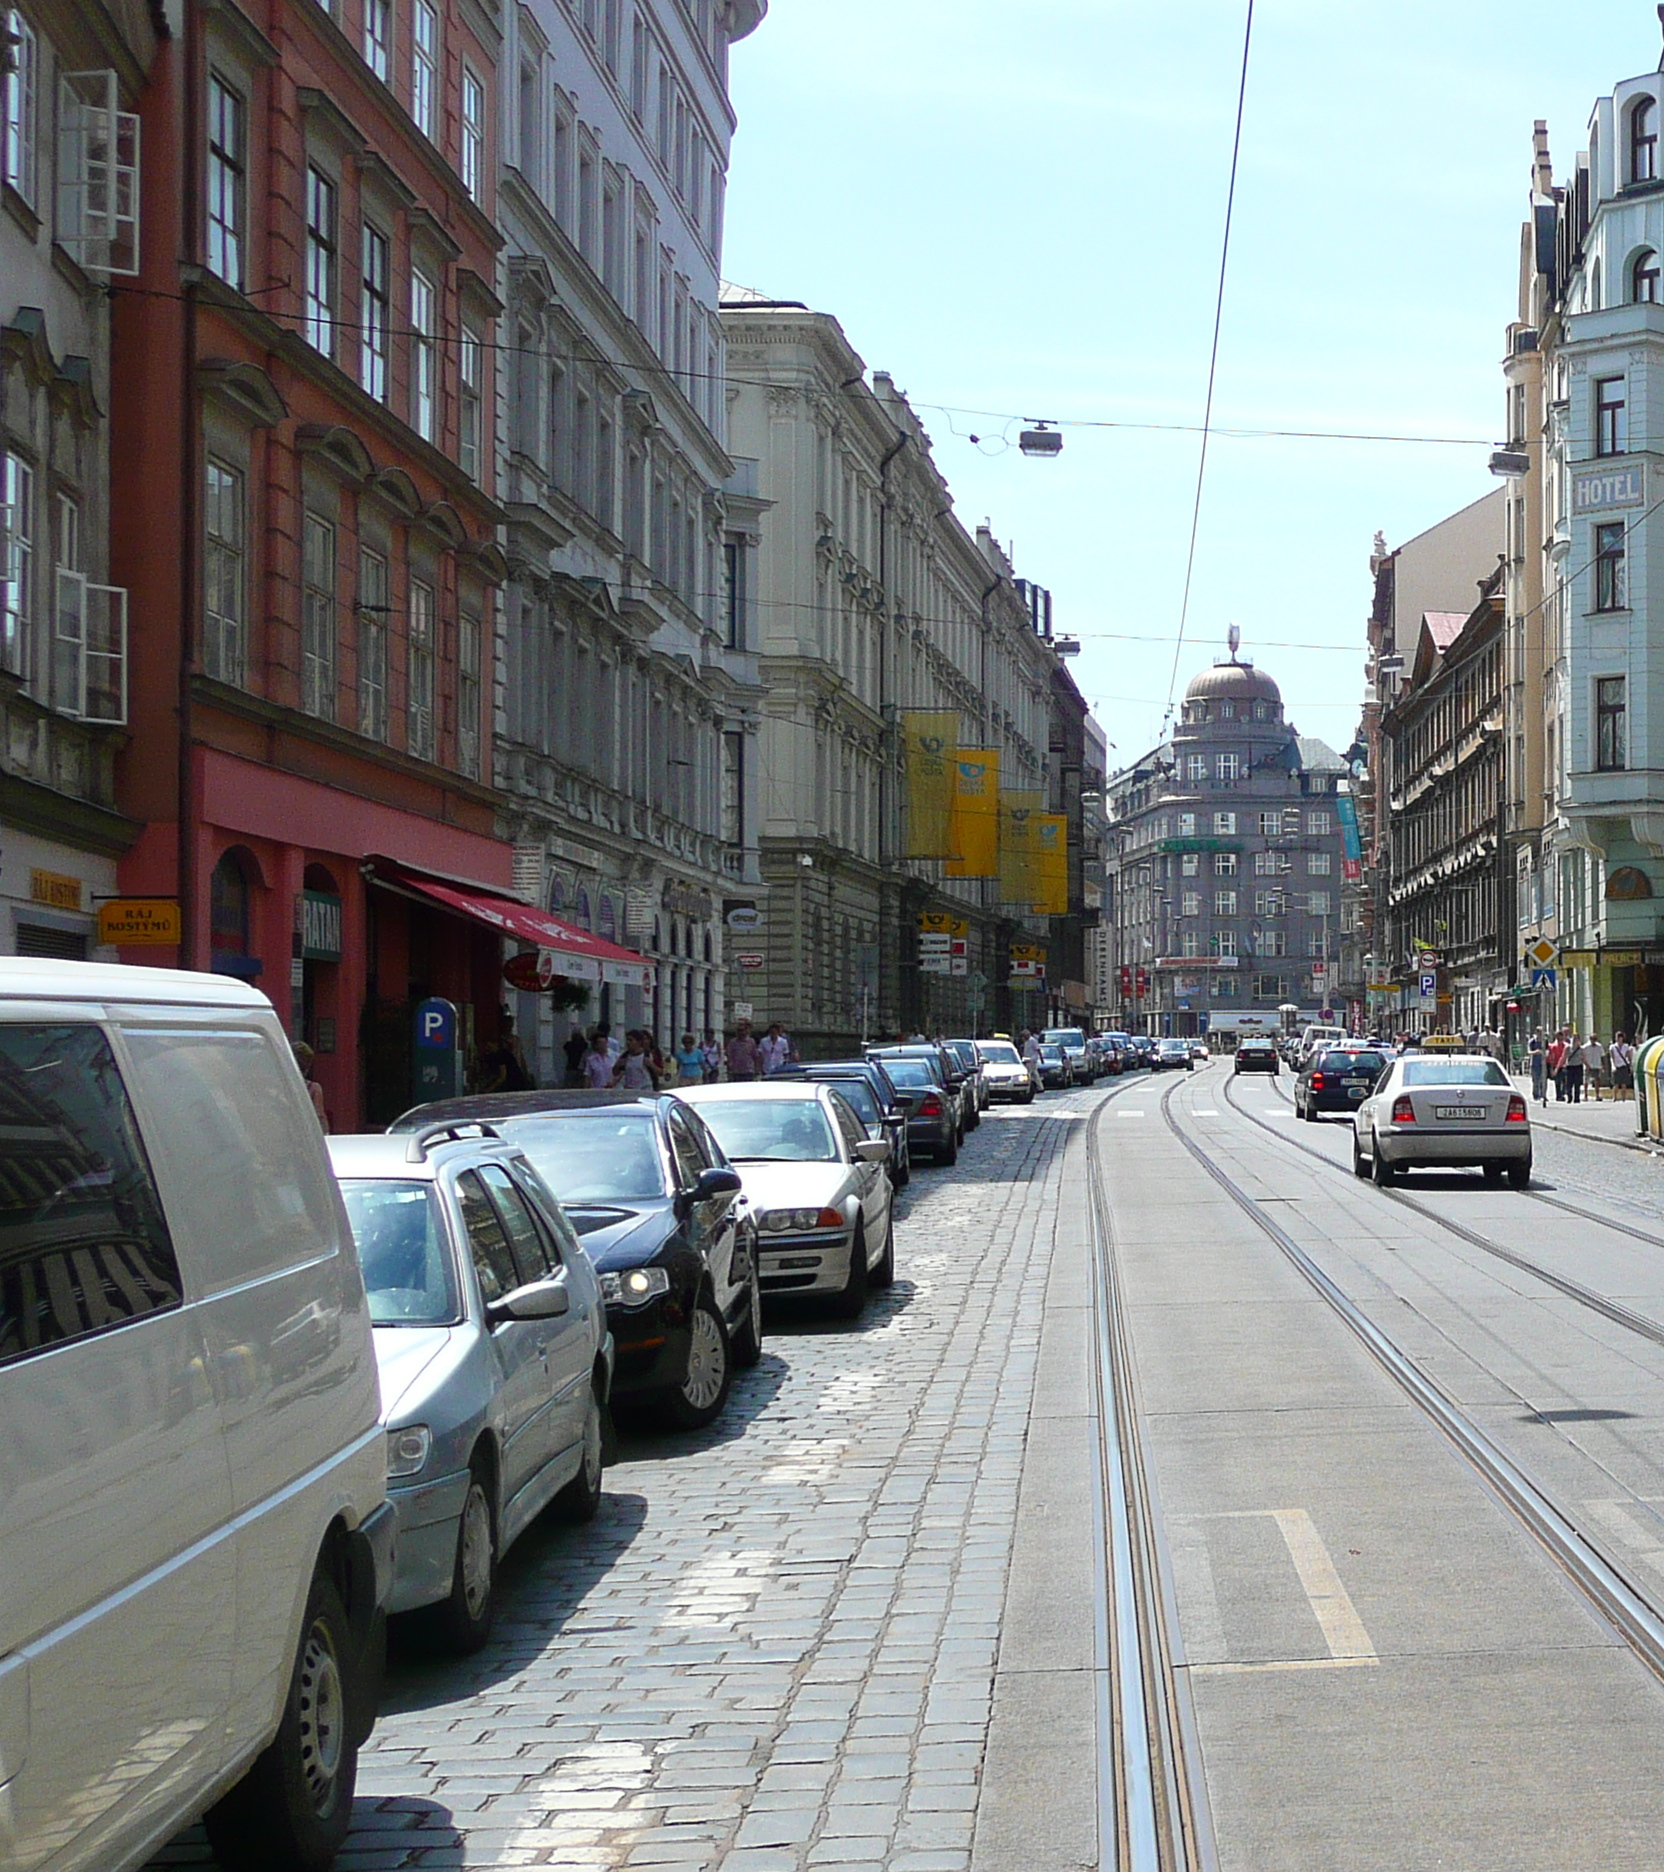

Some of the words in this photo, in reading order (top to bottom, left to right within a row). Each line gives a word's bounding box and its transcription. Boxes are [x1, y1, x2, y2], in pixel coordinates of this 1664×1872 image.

[1577, 474, 1640, 506] HOTEL
[107, 919, 171, 931] KOSTÝMŮ
[125, 906, 152, 919] RÁJ
[303, 899, 340, 953] RATAN
[1099, 931, 1107, 1002] DEBENHAMS
[1422, 977, 1432, 991] P
[425, 1012, 443, 1037] P
